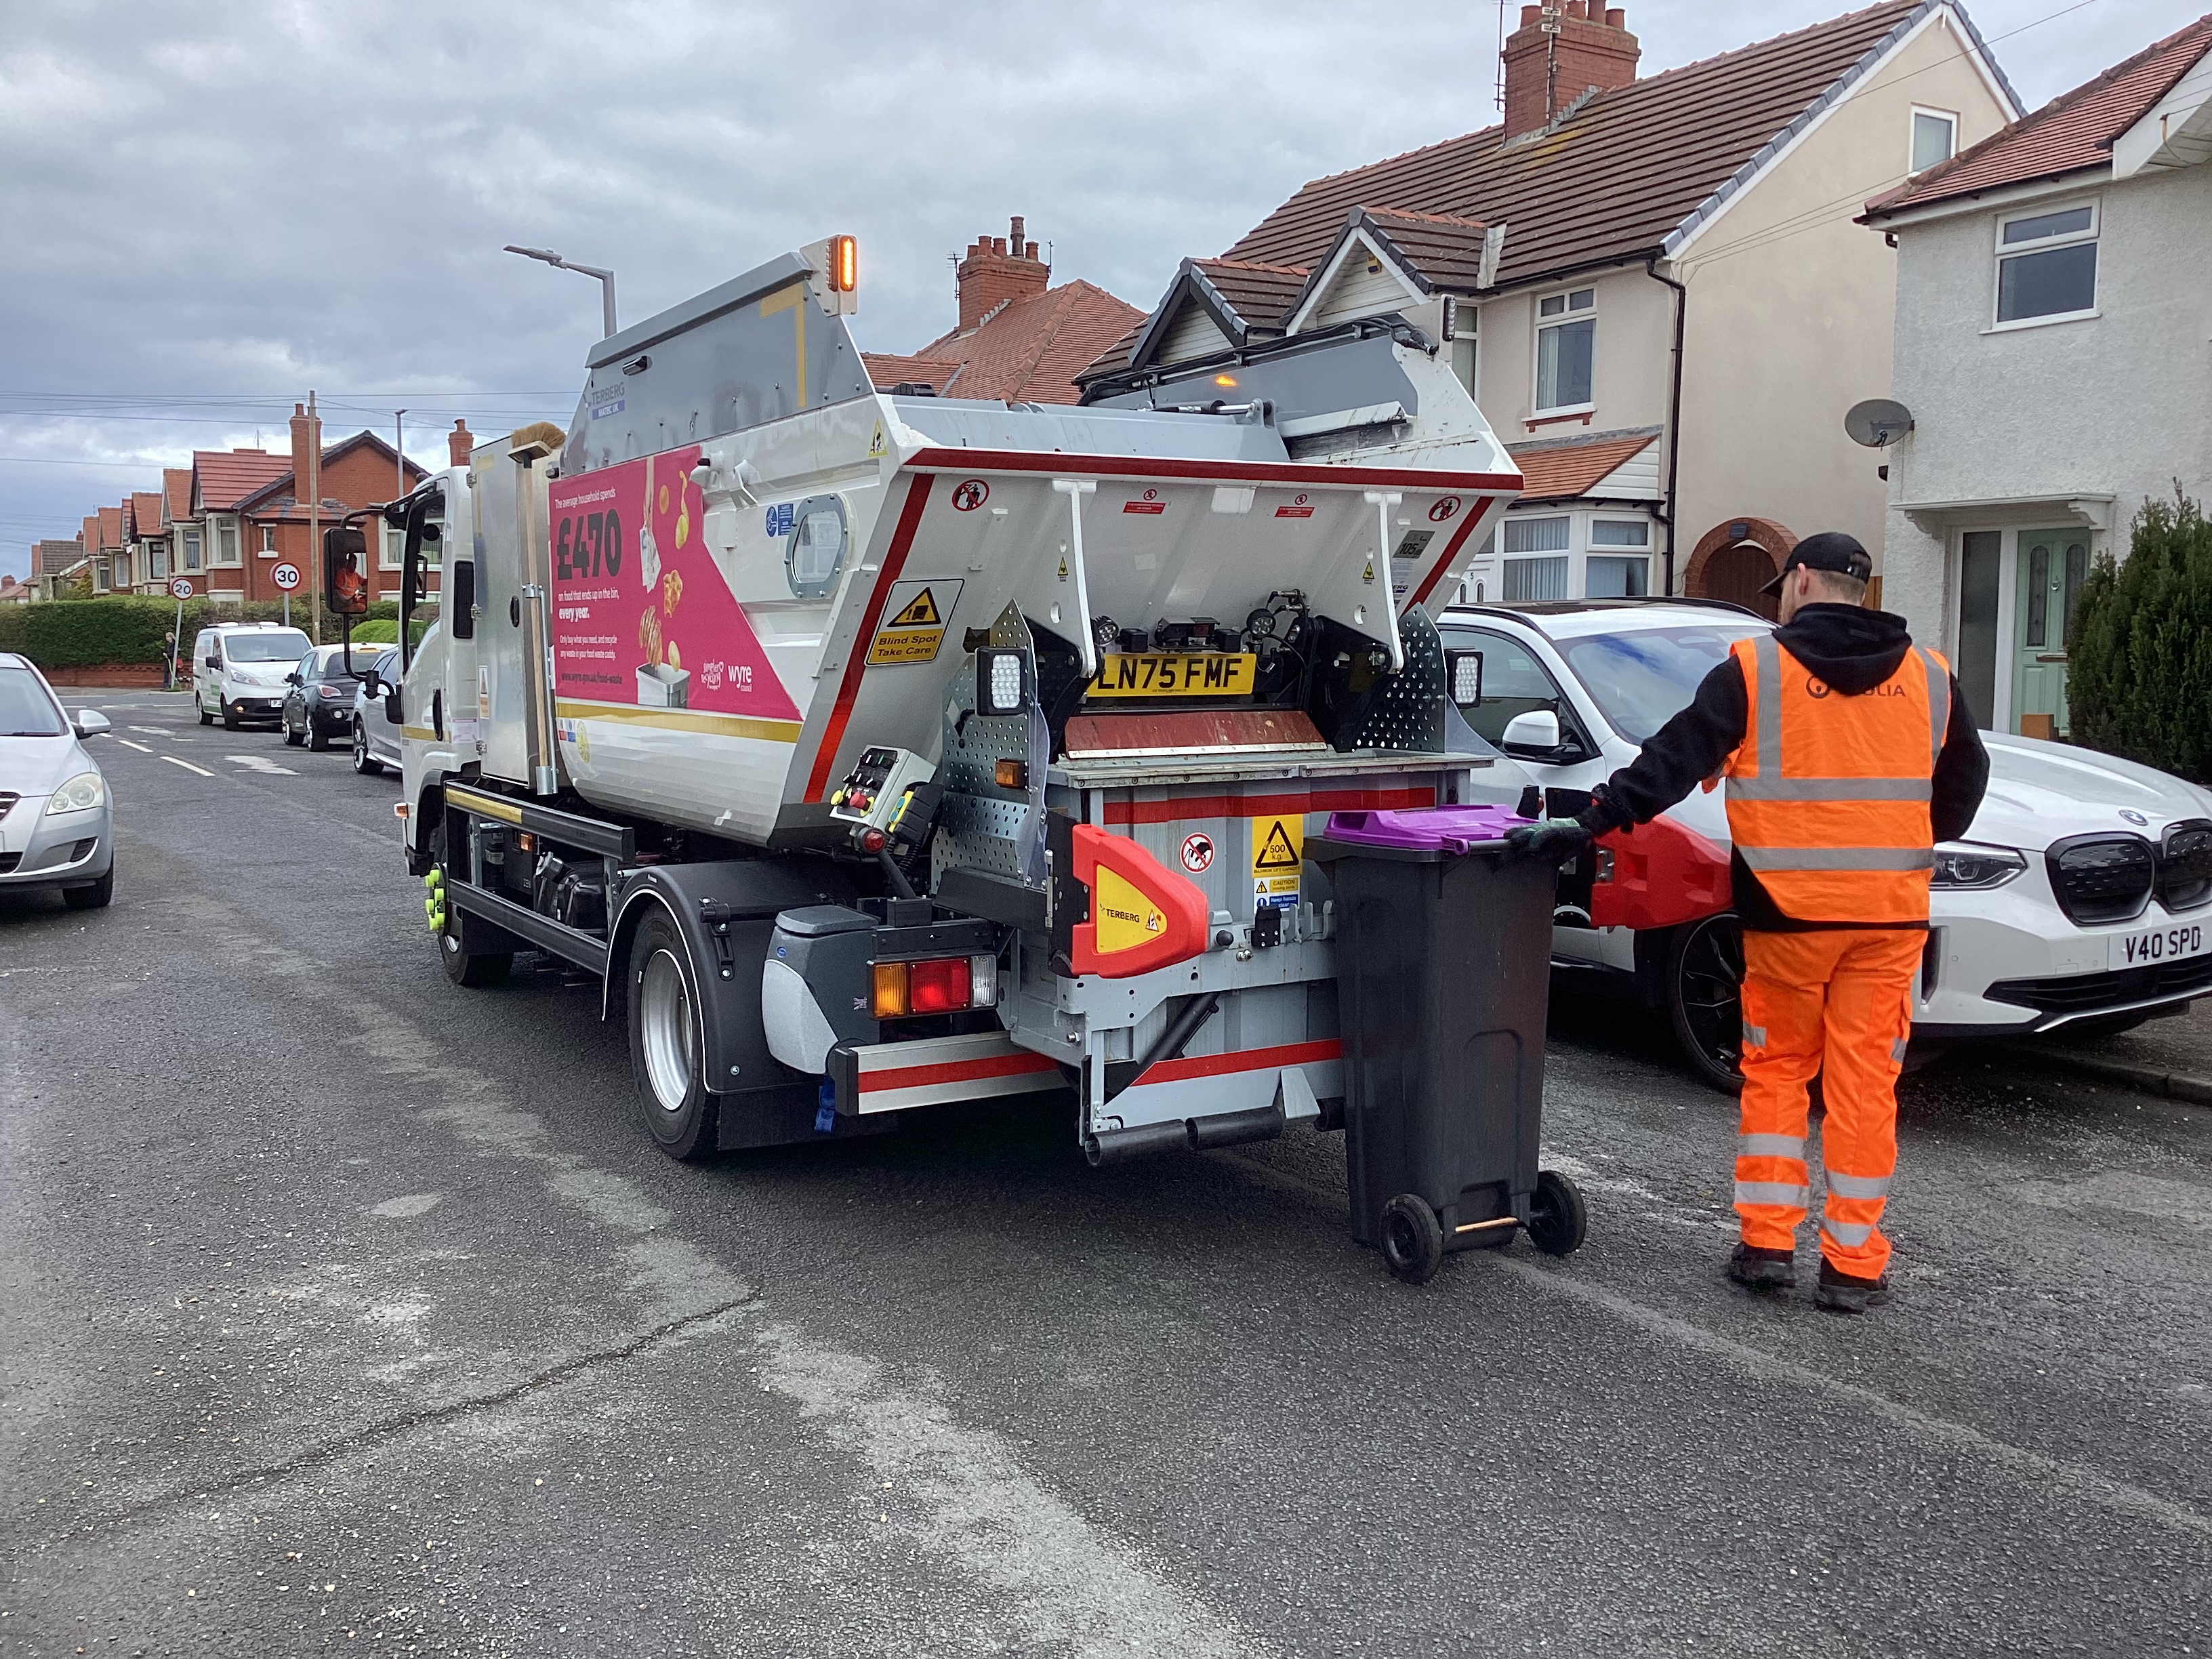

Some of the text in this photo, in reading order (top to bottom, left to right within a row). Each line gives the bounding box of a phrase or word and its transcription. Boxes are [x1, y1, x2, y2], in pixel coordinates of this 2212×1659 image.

[592, 382, 625, 405] TERBERG
[613, 403, 619, 413] UK
[562, 497, 578, 508] average
[578, 489, 600, 504] household
[600, 486, 616, 502] spends
[557, 509, 621, 580] £470
[1399, 543, 1419, 554] 105
[277, 570, 298, 582] 30
[1470, 572, 1474, 580] 5
[175, 584, 191, 594] 20
[564, 590, 573, 601] food
[573, 590, 581, 600] that
[581, 589, 592, 600] ends
[592, 591, 598, 602] up
[598, 588, 602, 599] in
[602, 588, 611, 599] the
[559, 607, 590, 622] every year.
[879, 635, 937, 645] Blind Spot
[728, 665, 752, 689] wyre
[1098, 658, 1242, 689] LN75 FMF
[1269, 844, 1286, 853] 500
[1106, 908, 1140, 923] TERBERG
[2126, 926, 2200, 962] V40 SPD
